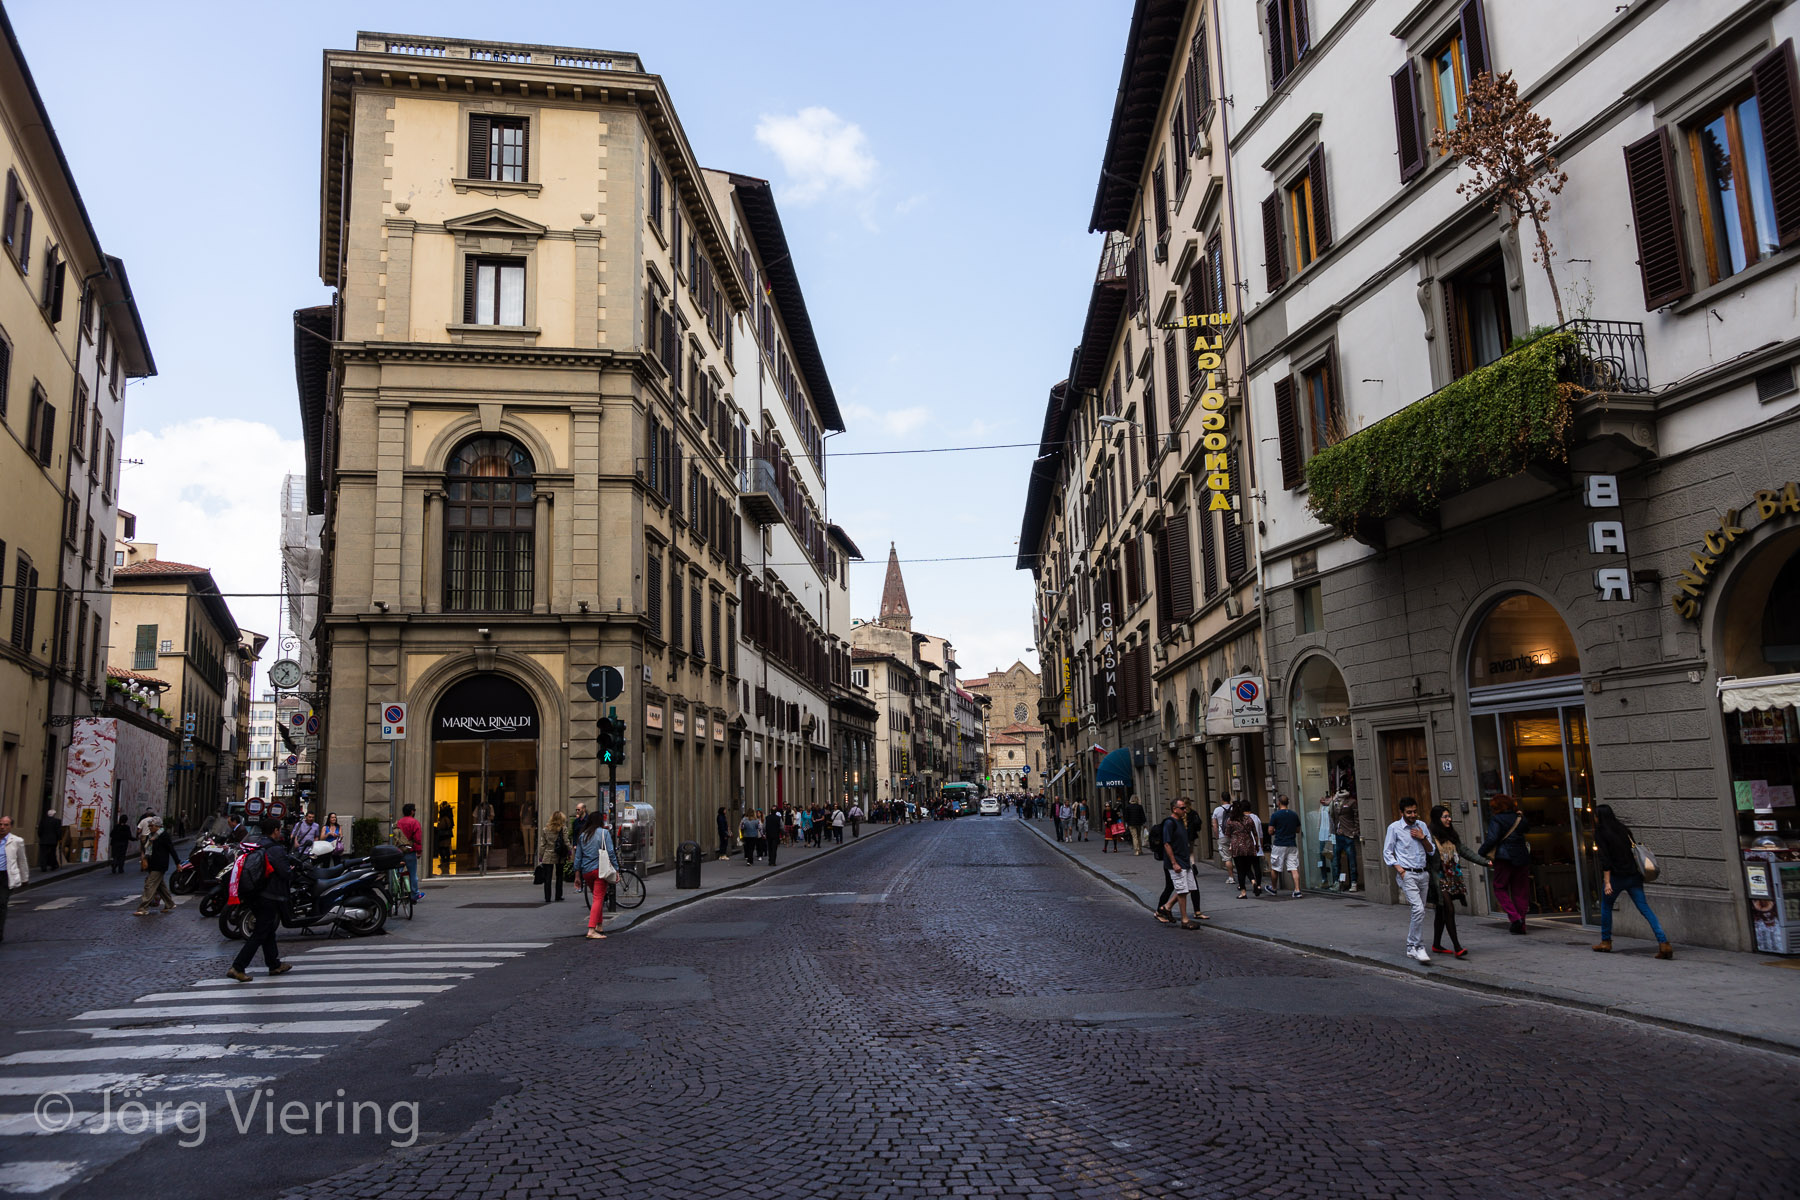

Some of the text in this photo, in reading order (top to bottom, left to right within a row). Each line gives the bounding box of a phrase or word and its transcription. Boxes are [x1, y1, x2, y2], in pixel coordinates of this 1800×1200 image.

[1672, 509, 1746, 619] SNACK
[1489, 648, 1560, 674] avantgarde
[1063, 657, 1072, 715] MARTELLI
[442, 716, 531, 730] MARINA RINALDI
